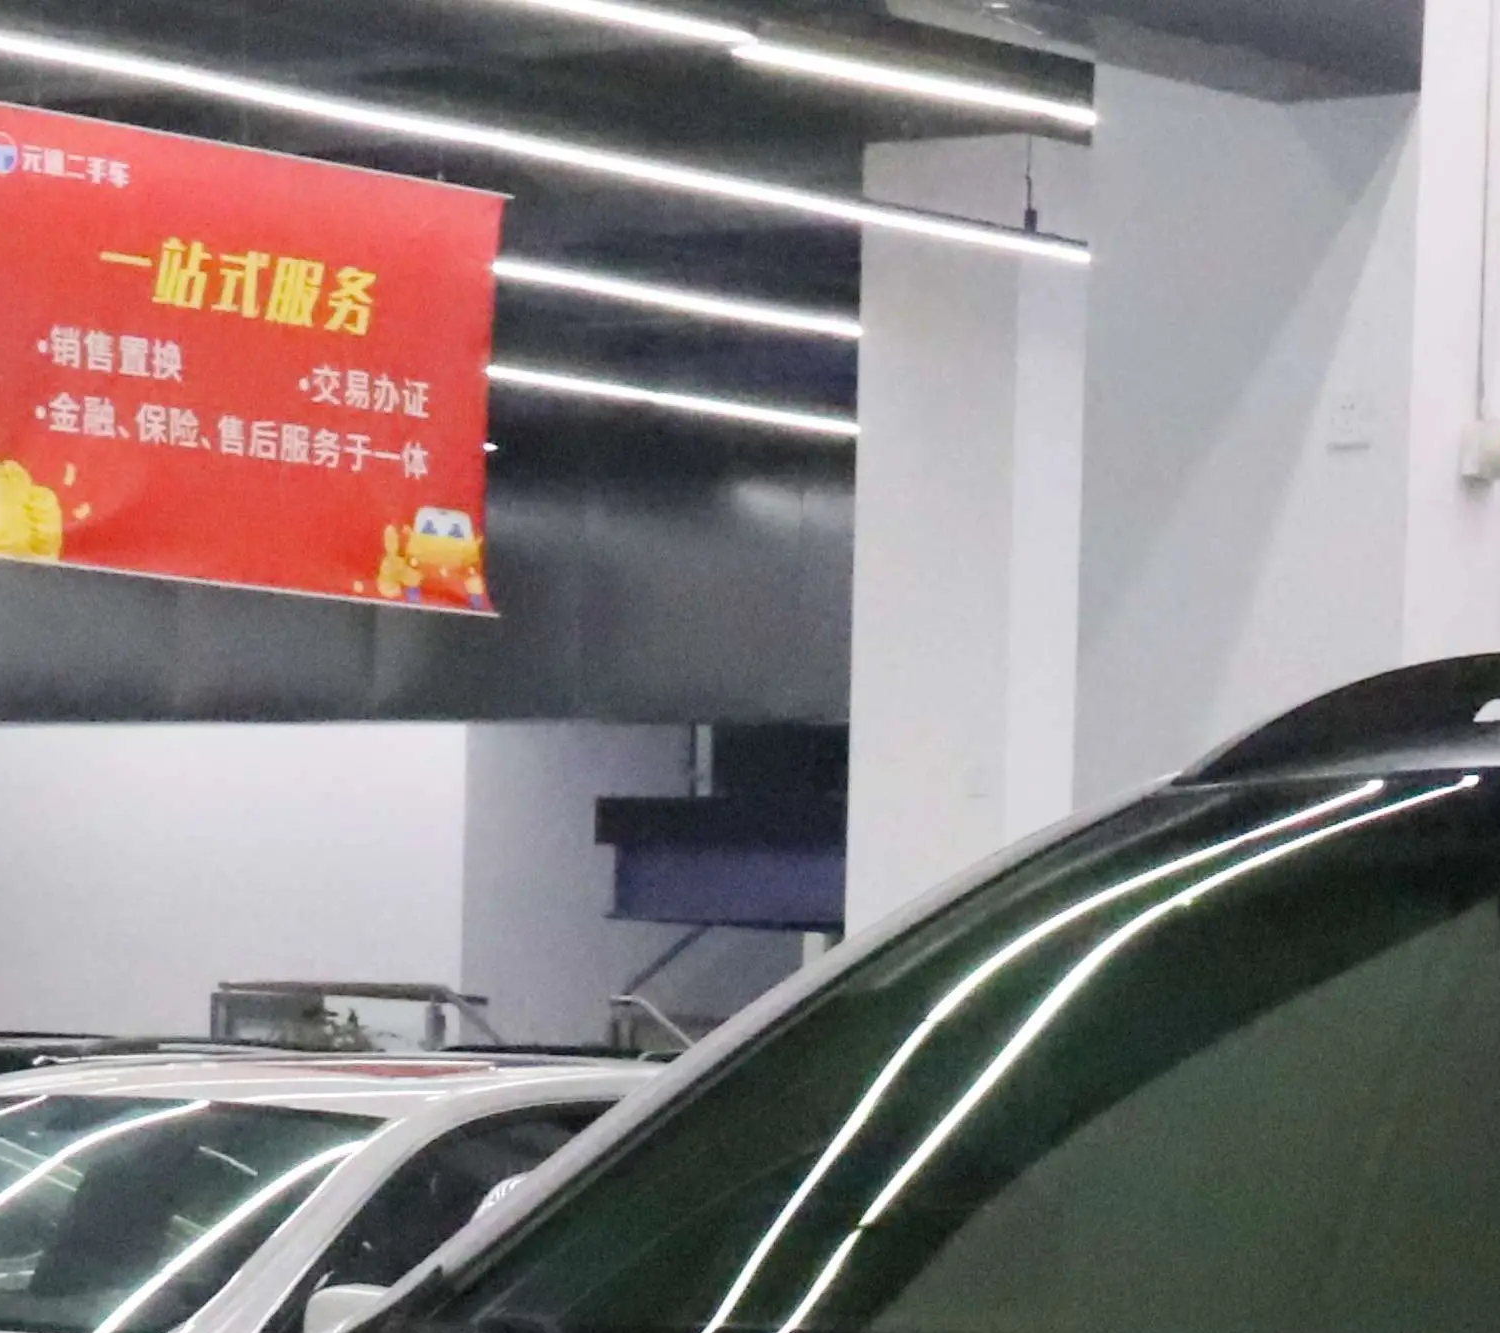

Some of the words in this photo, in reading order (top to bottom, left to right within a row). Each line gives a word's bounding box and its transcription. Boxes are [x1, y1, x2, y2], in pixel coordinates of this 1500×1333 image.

[99, 236, 377, 336] 一站式服务
[50, 323, 183, 383] 销售置换
[311, 364, 430, 419] 交易办证
[48, 391, 429, 480] 金融、保险、售后服务于一体
